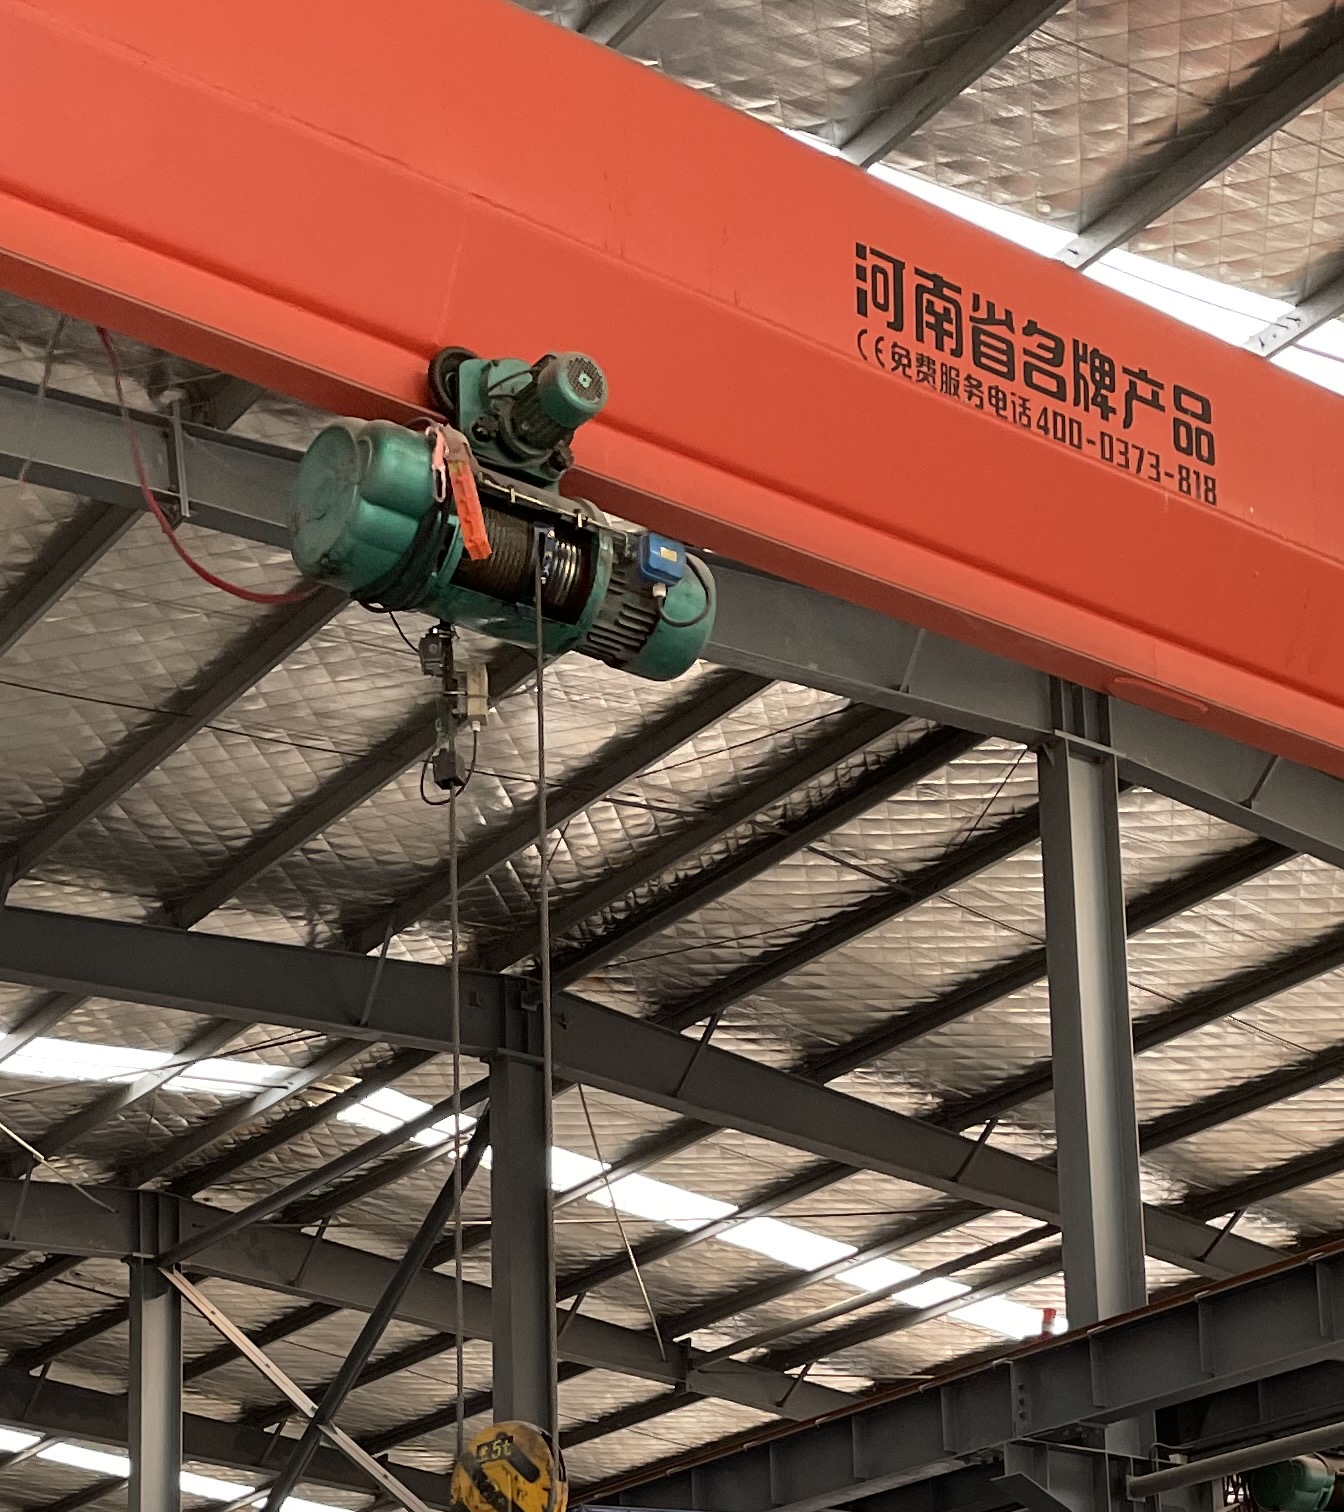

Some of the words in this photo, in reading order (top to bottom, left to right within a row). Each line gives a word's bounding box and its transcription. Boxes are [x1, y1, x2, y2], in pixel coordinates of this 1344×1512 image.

[855, 241, 1216, 466] 河南省名牌产品
